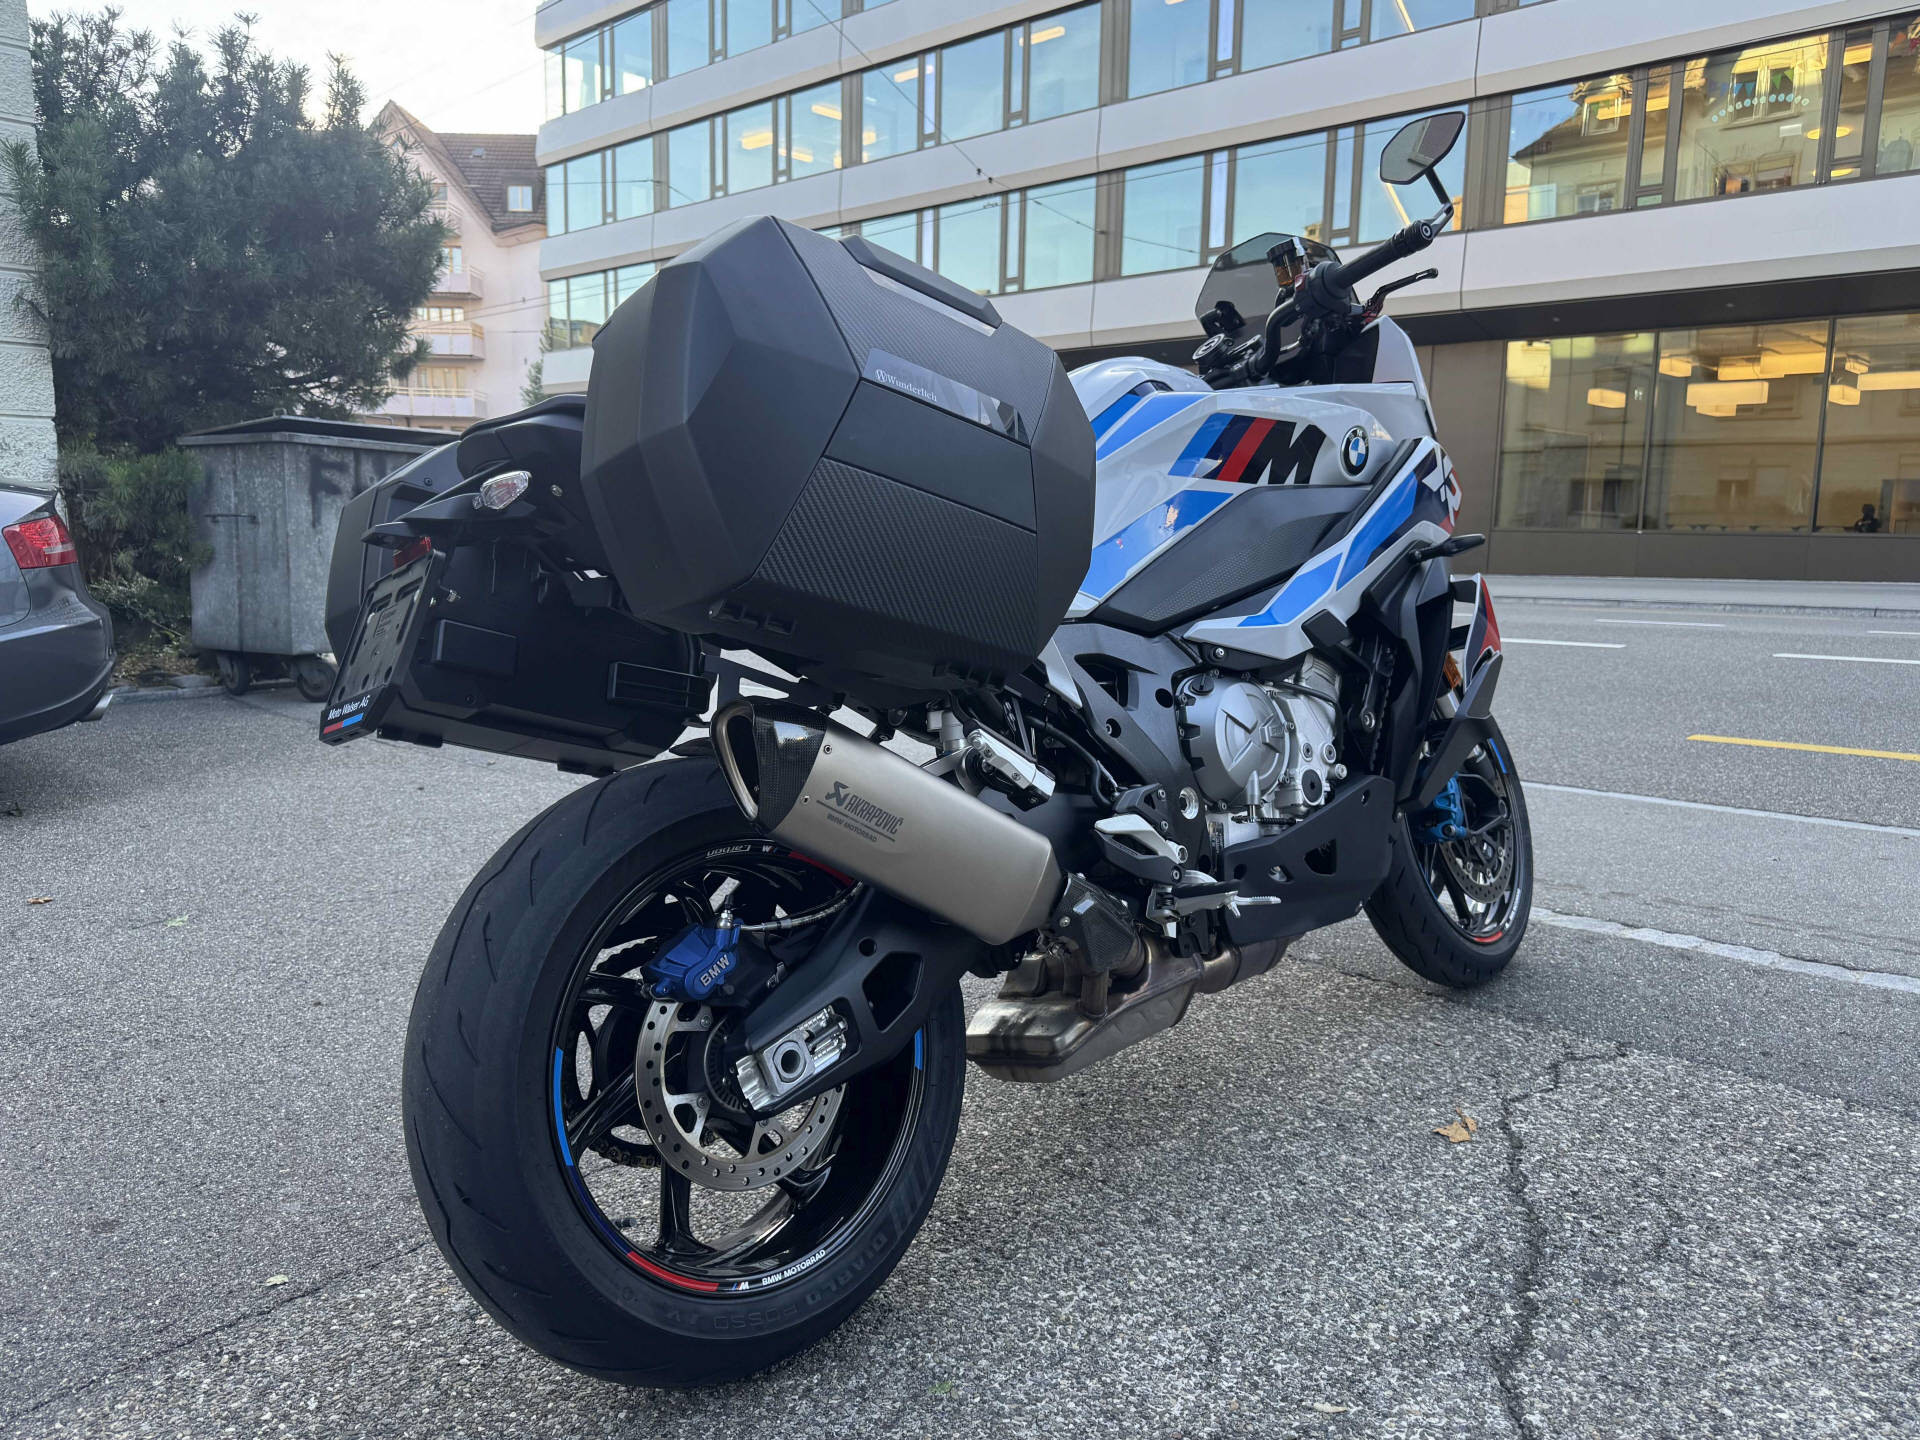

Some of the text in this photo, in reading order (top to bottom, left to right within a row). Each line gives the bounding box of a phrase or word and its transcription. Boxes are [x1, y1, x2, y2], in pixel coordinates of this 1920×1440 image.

[887, 374, 938, 402] Wunderlich
[328, 708, 342, 720] Moto
[359, 694, 371, 709] AG
[701, 954, 730, 986] BMW
[761, 1249, 826, 1286] BMW MOTORRAD
